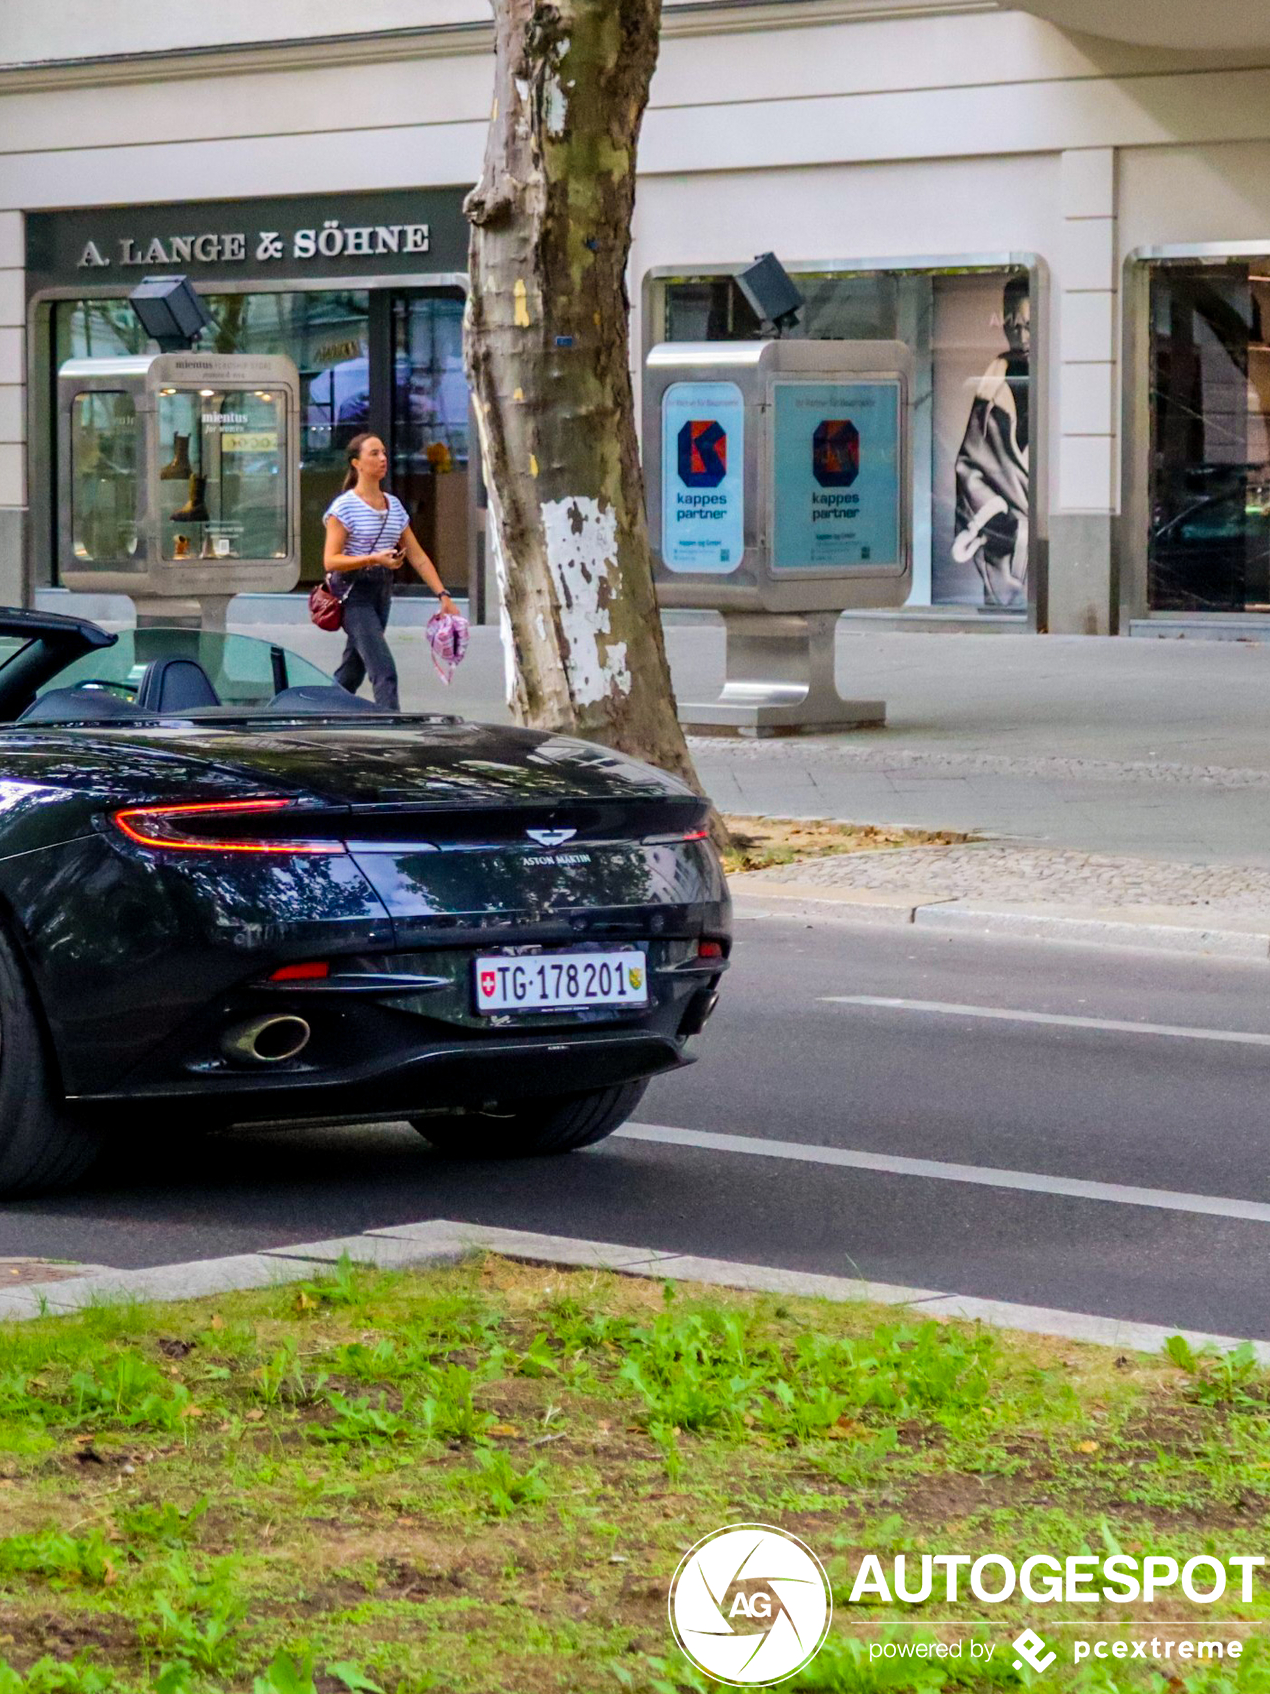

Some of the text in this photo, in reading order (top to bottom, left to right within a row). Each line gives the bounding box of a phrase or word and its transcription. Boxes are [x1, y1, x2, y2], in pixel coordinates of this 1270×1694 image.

[77, 220, 429, 267] A. LANGE & SÖHNE
[201, 410, 249, 424] mientus
[676, 492, 728, 507] kappes
[812, 492, 860, 506] kappes
[676, 508, 728, 521] partner
[812, 508, 860, 522] partner
[523, 854, 591, 866] ASTON MARTIN
